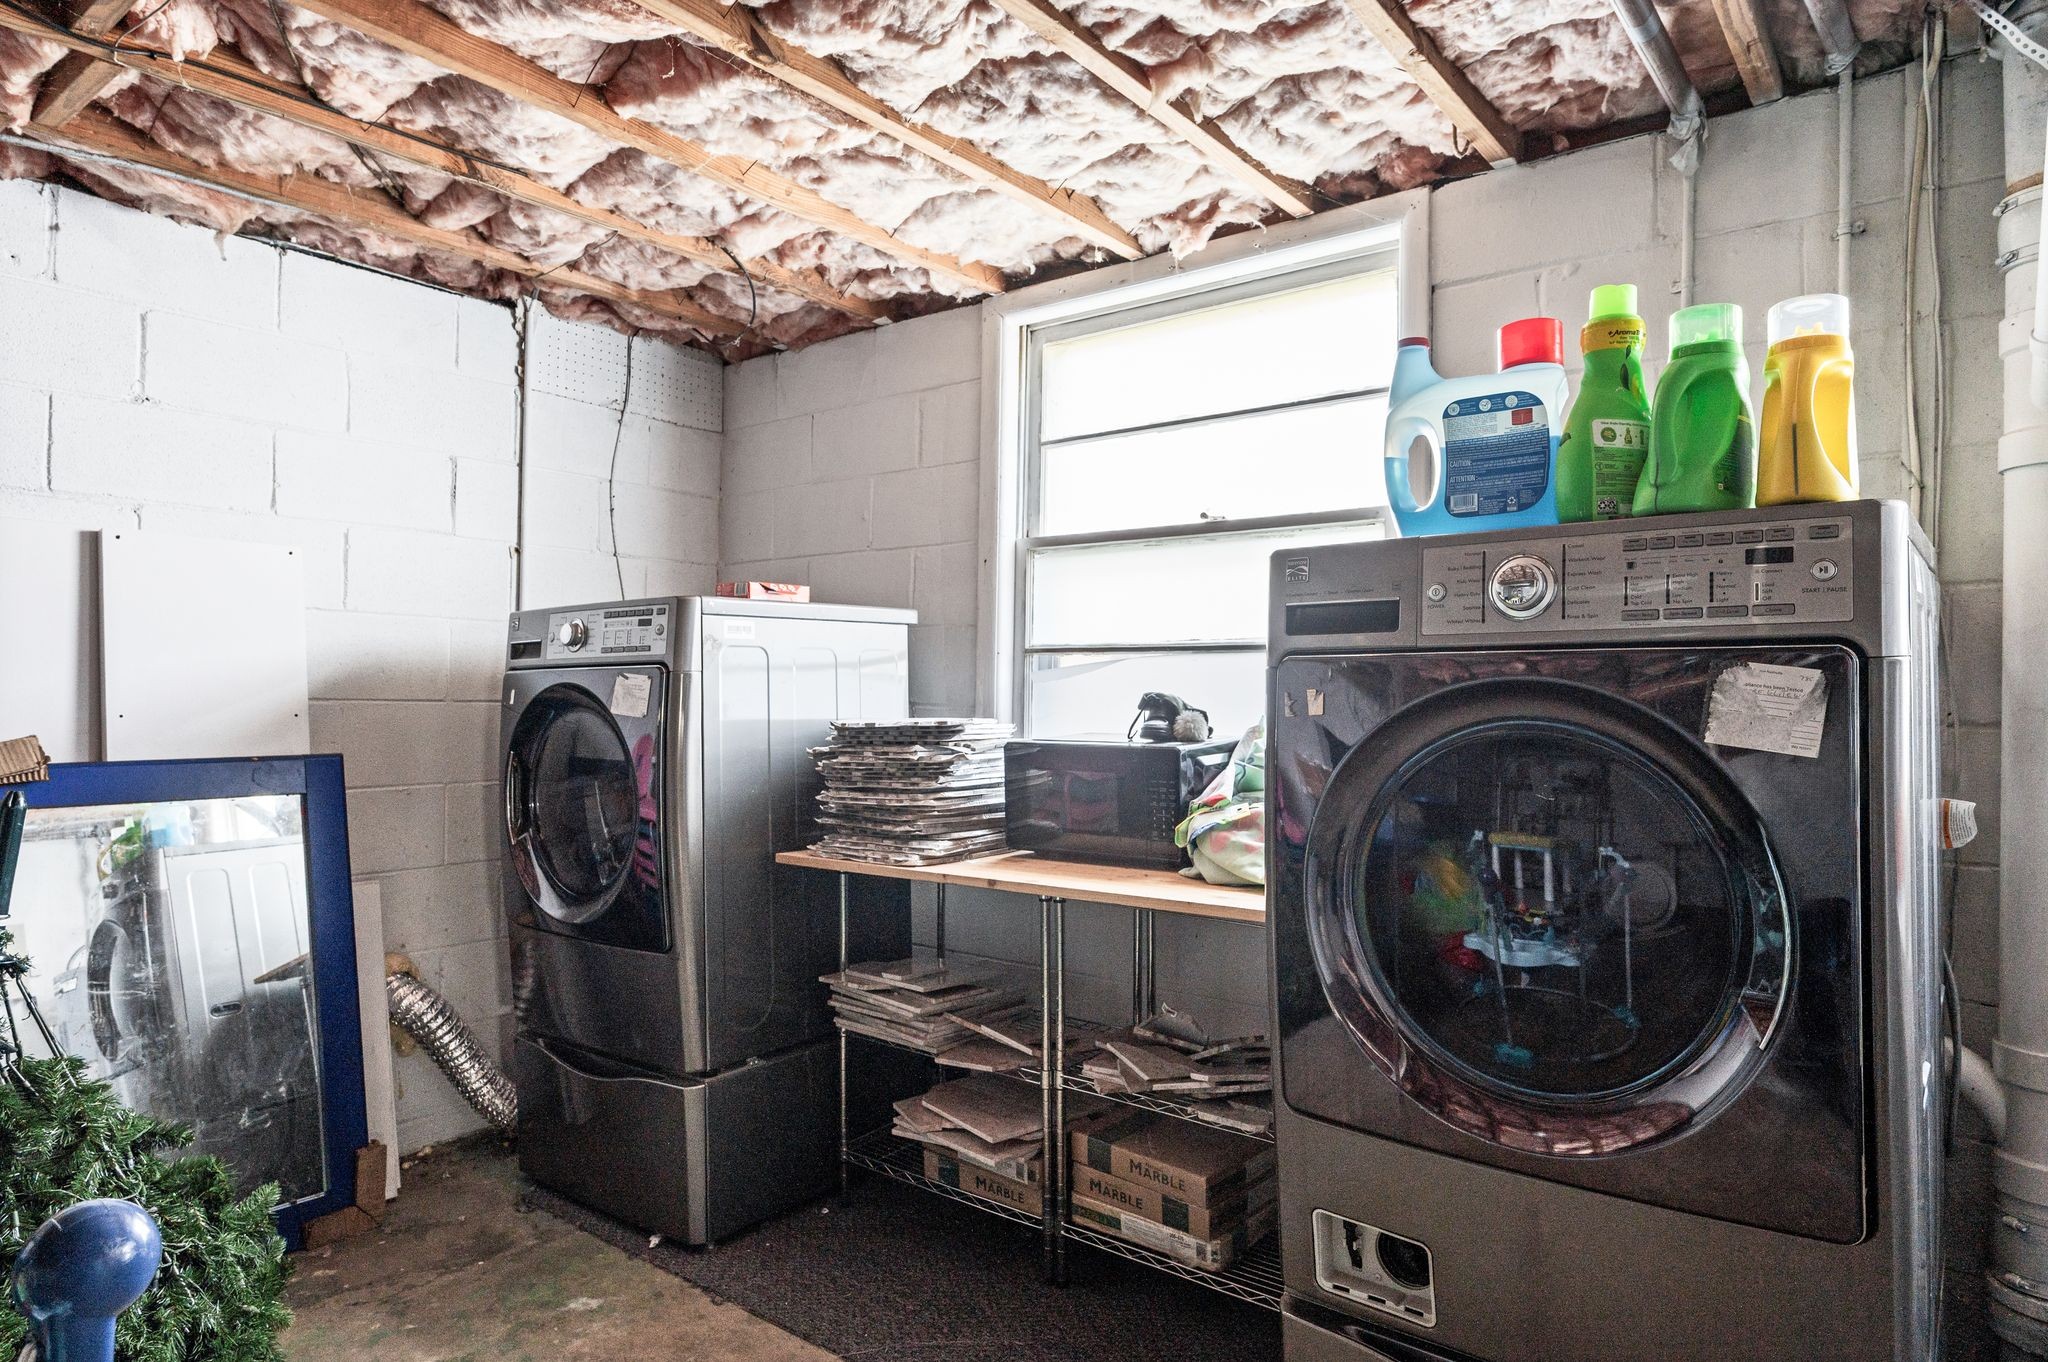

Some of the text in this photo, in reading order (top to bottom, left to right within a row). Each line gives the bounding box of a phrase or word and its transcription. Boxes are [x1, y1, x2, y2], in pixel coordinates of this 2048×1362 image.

[975, 1175, 1025, 1204] MARBLE
[1129, 1158, 1186, 1192] MARBLE
[1089, 1177, 1143, 1210] MARBLE
